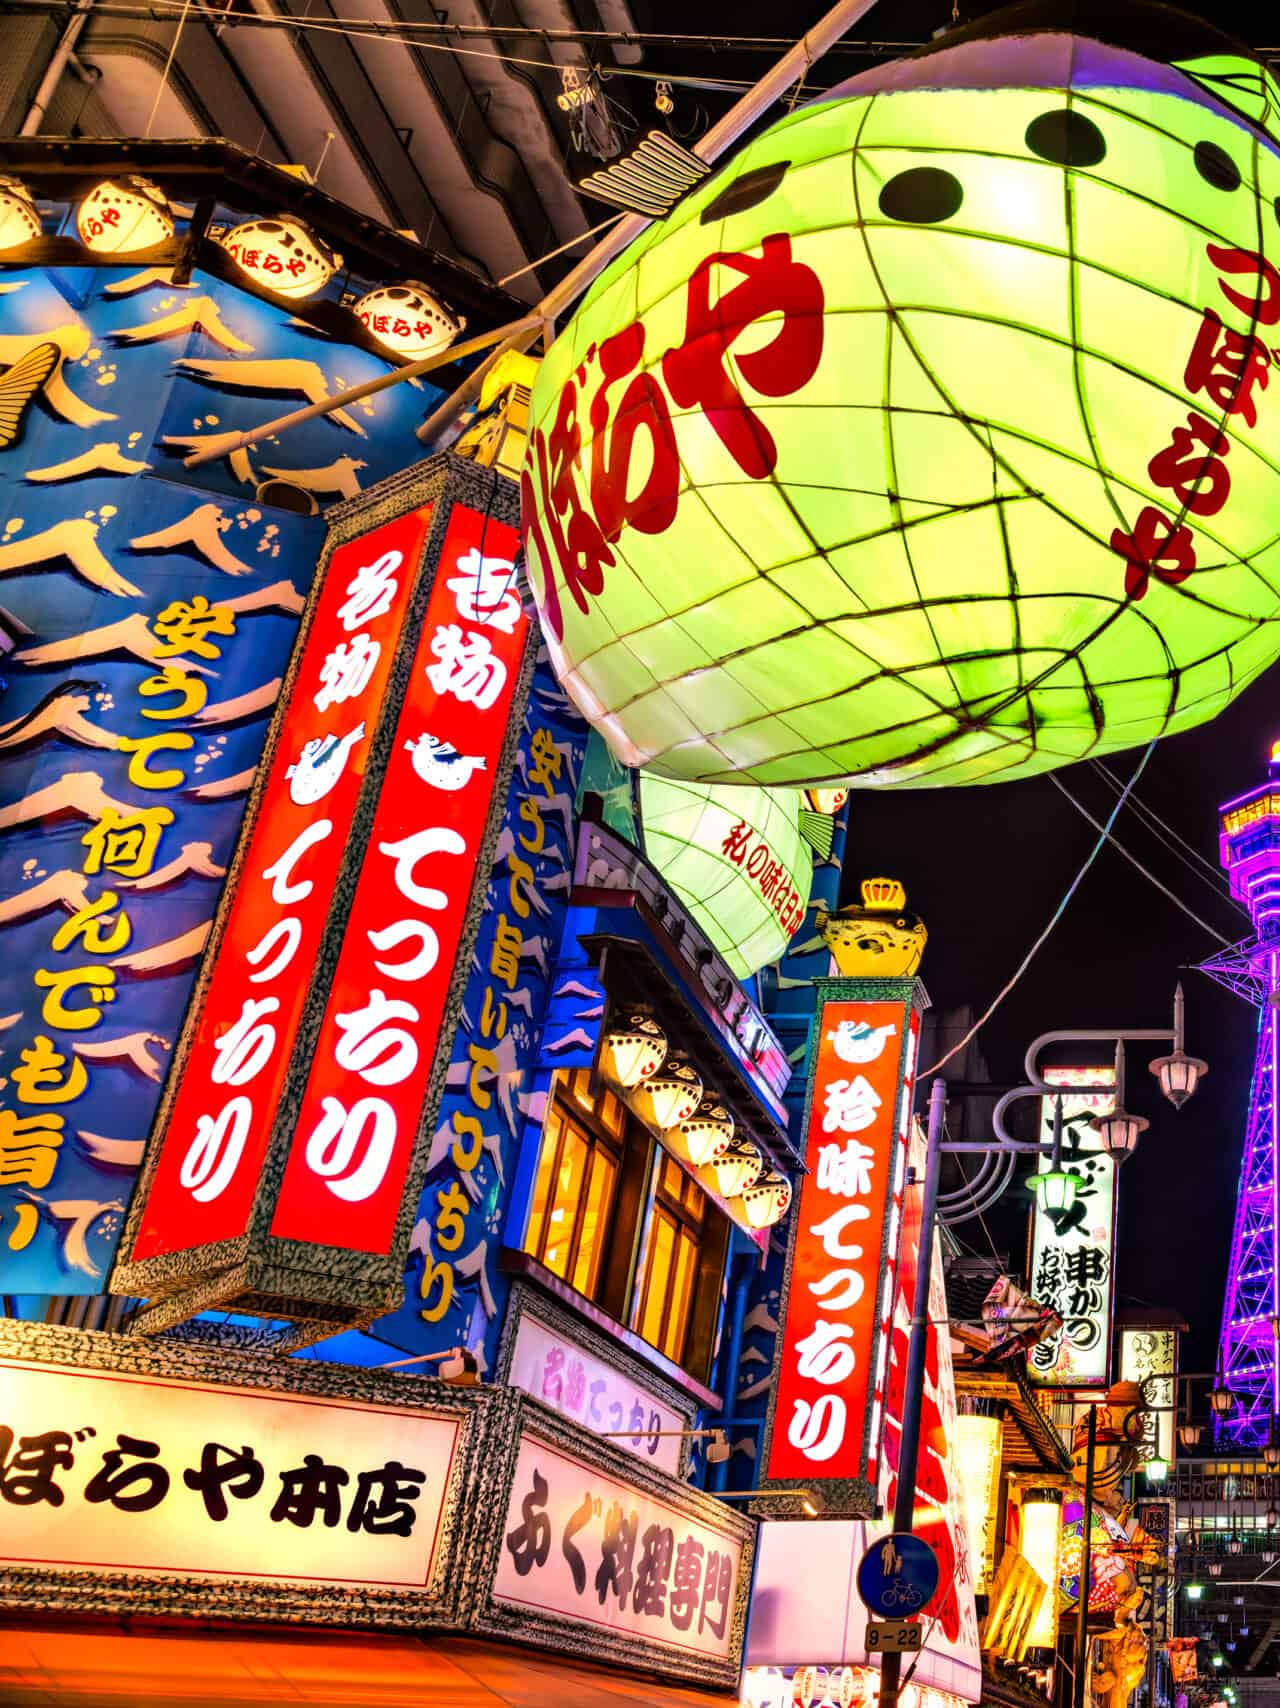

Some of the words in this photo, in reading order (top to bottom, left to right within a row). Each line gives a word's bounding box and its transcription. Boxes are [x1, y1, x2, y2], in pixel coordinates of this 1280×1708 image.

[179, 818, 335, 1203] てっちり
[304, 826, 467, 1203] てっちり
[787, 1074, 882, 1462] 珍味てっちり
[1034, 1246, 1063, 1367] お好みき
[1063, 1245, 1106, 1349] 串かつ
[506, 1467, 732, 1641] ふぐ料理専門
